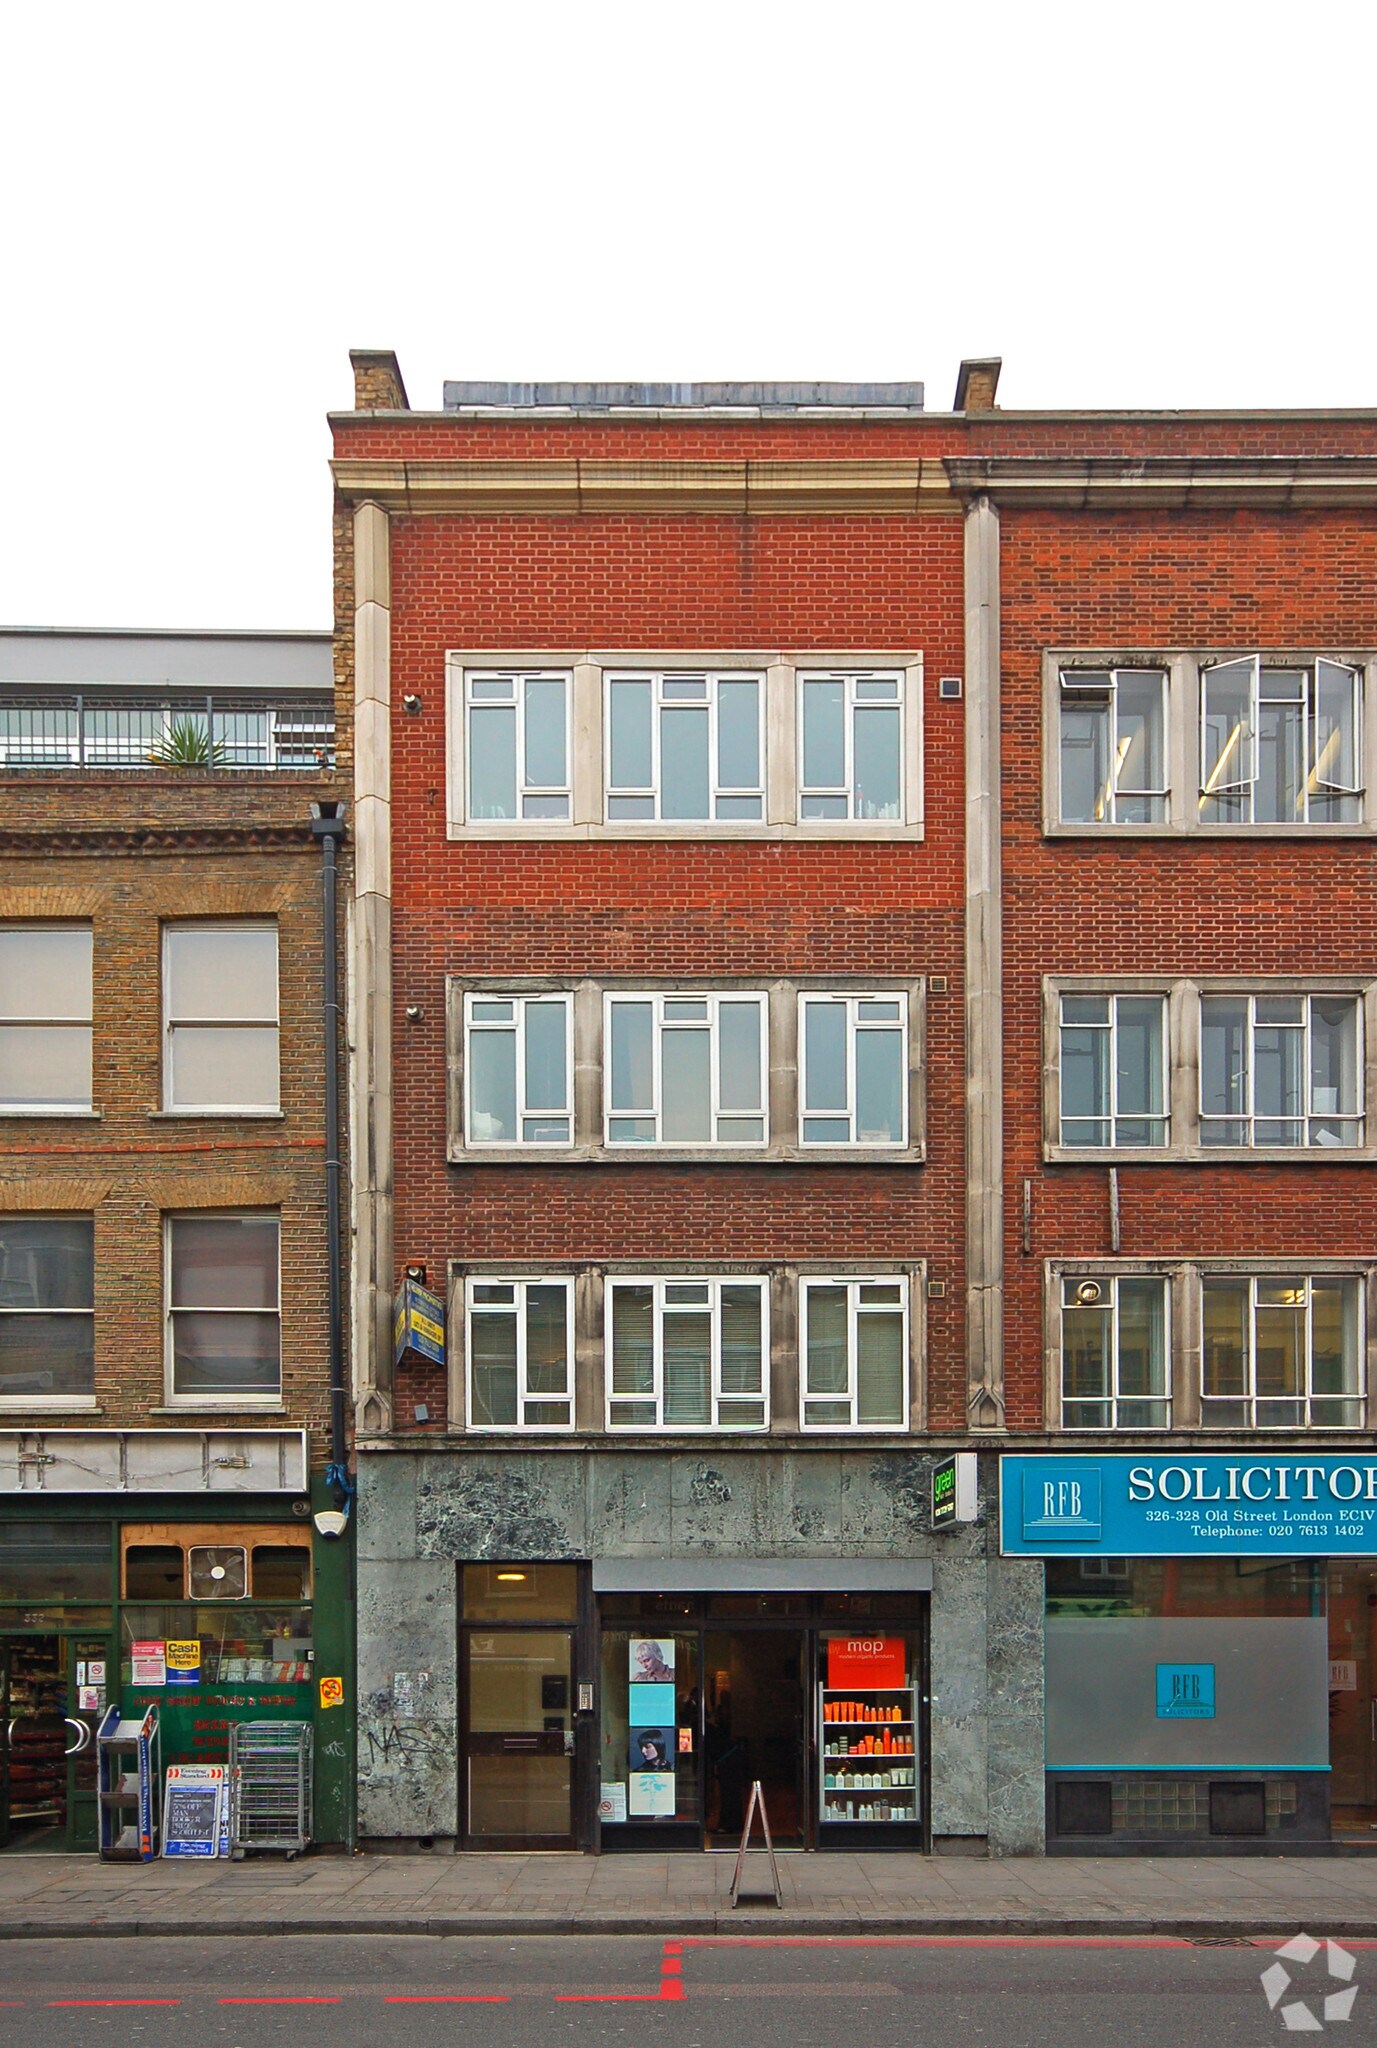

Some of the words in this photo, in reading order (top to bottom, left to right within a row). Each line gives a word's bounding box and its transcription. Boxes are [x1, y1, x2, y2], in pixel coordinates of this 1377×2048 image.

[935, 1468, 955, 1502] green
[1043, 1481, 1082, 1516] RFB
[1145, 1510, 1200, 1521] 326-328
[1205, 1510, 1228, 1521] Old
[1233, 1510, 1277, 1521] Street
[1283, 1510, 1333, 1521] London
[1339, 1510, 1375, 1521] EC1V
[1190, 1525, 1263, 1539] Telephone:
[1268, 1525, 1293, 1536] 020
[1299, 1525, 1328, 1536] 7613
[1334, 1525, 1364, 1536] 1402
[168, 1643, 198, 1653] Cash
[847, 1640, 884, 1654] mop
[168, 1652, 198, 1660] Machine
[1172, 1674, 1200, 1699] RFB
